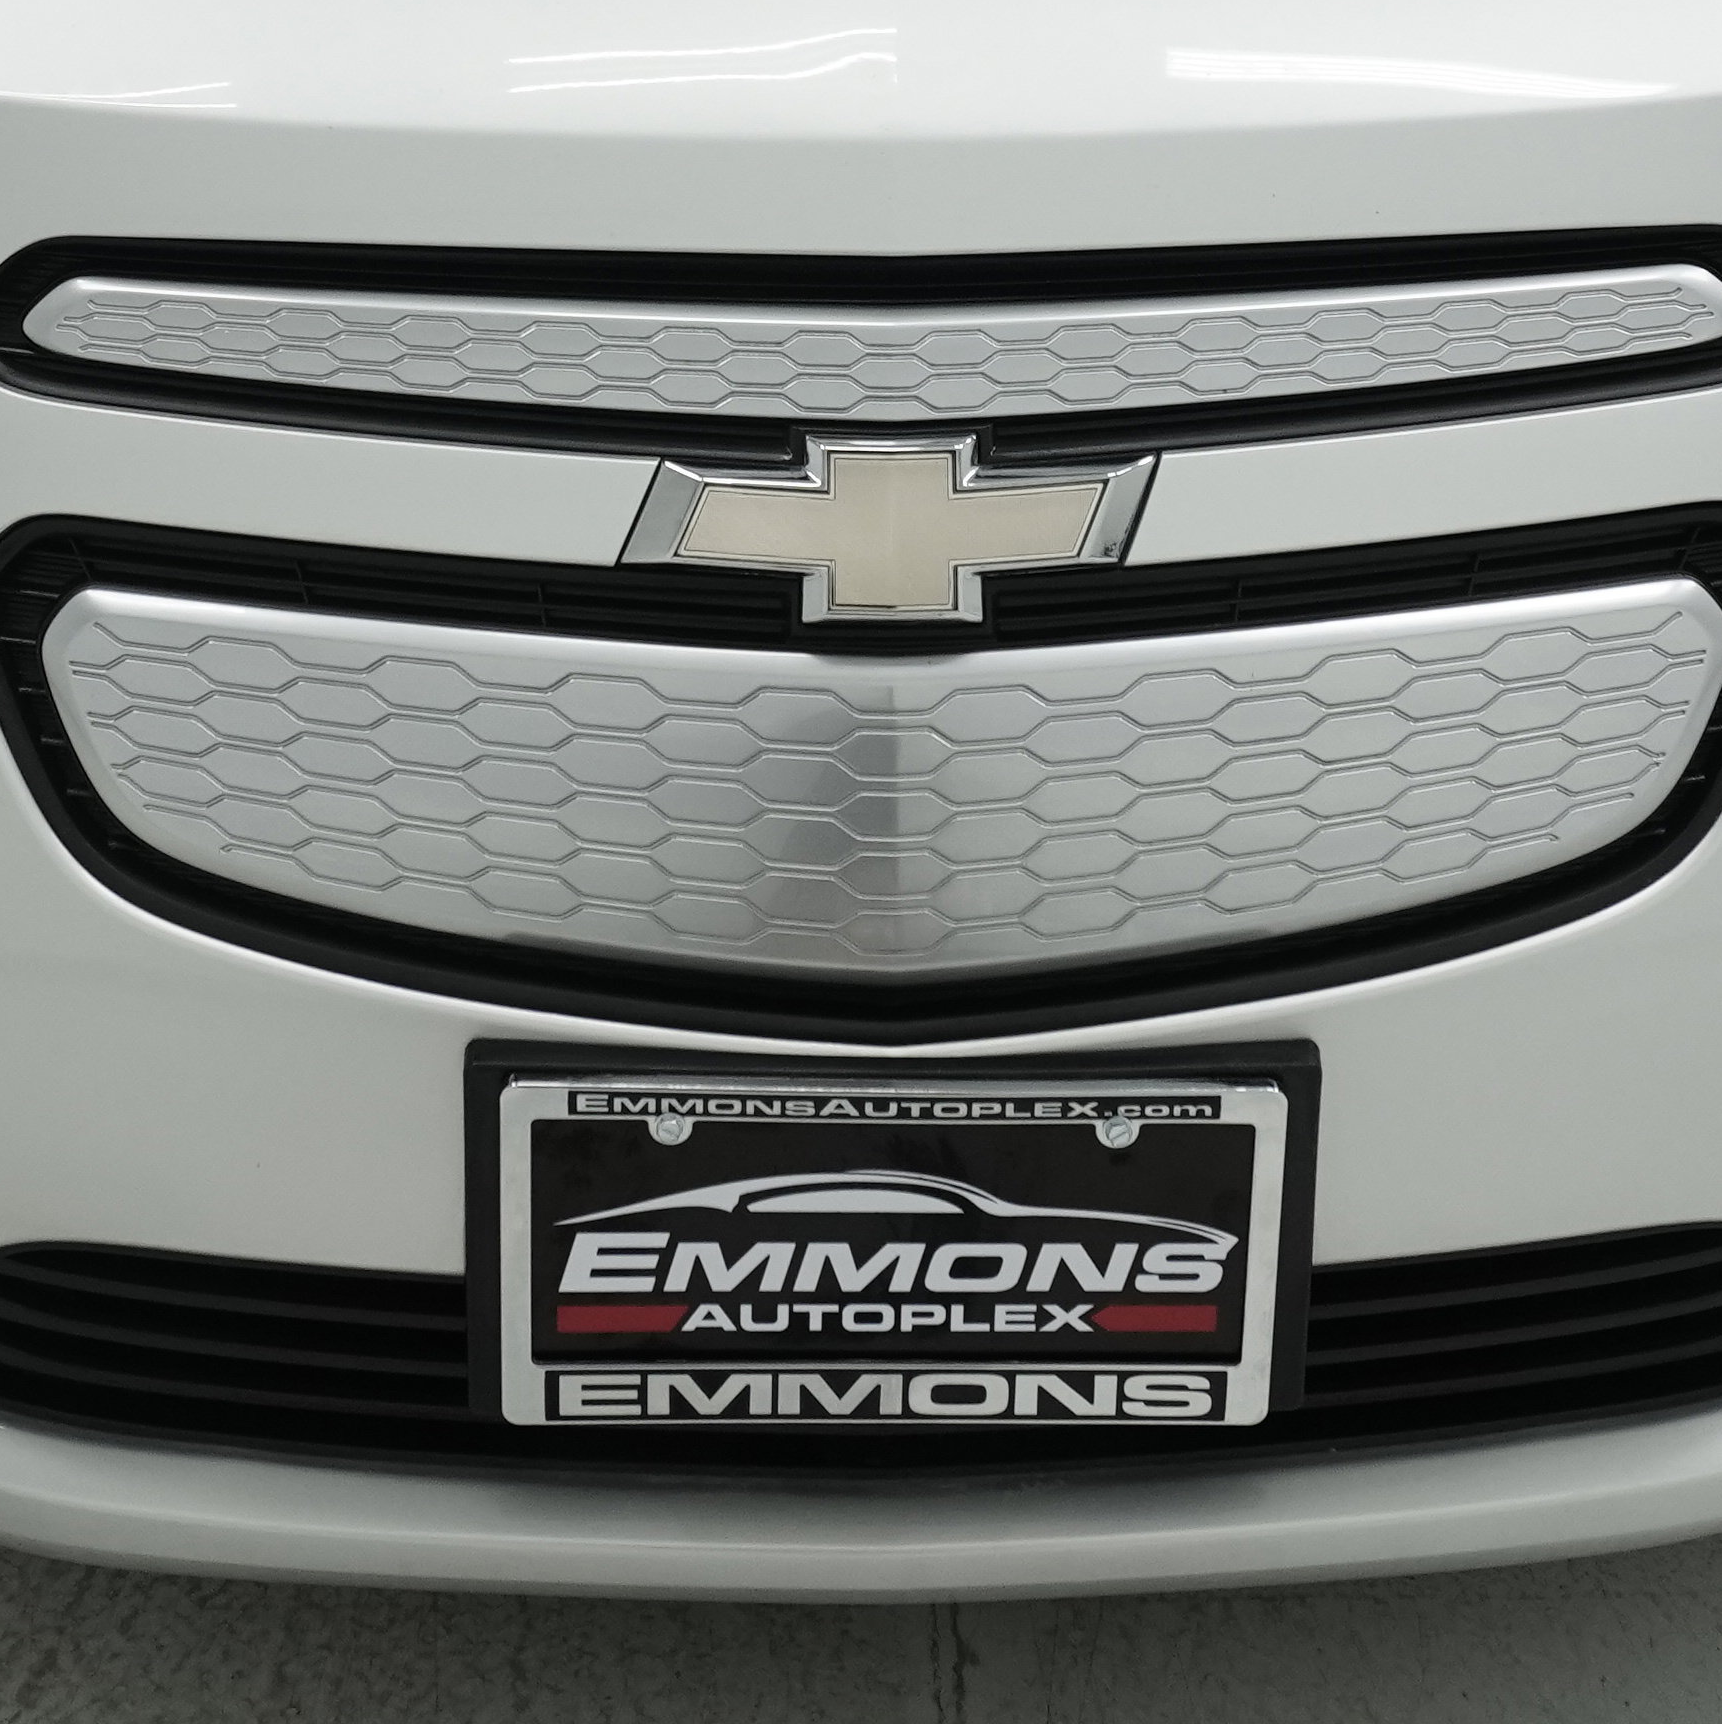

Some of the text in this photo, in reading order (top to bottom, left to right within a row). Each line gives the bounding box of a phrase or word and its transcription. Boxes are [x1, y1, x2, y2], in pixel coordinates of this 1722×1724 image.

[557, 1231, 1230, 1294] EMMONS
[681, 1304, 1095, 1332] AUTOPLEX
[558, 1373, 1213, 1417] EMMONS
